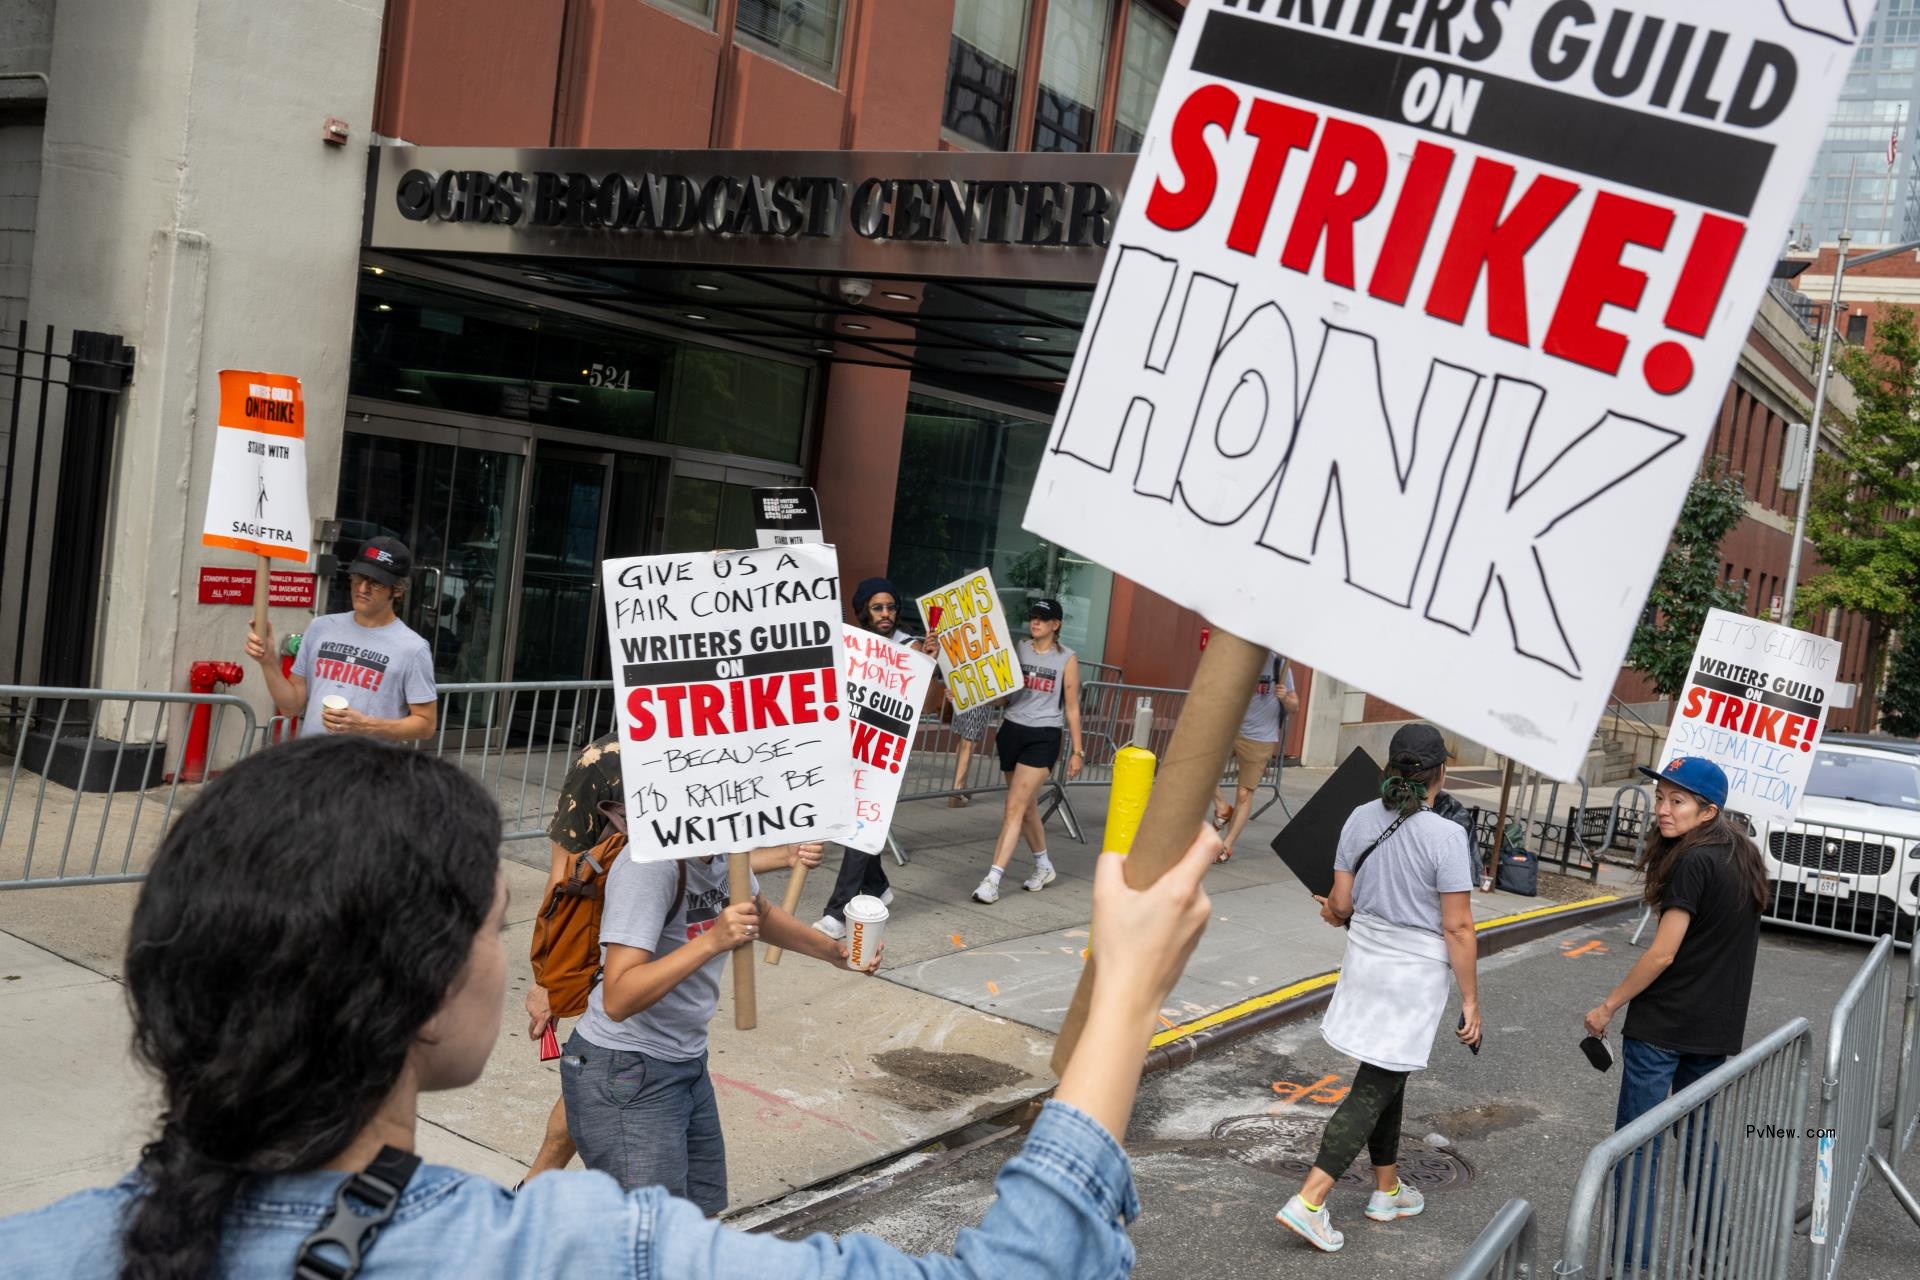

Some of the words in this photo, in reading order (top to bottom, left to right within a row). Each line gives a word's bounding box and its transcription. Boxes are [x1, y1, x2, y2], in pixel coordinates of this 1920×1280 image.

[1530, 0, 1800, 131] GUILD
[1402, 66, 1485, 136] ON
[434, 169, 527, 226] CBS
[529, 171, 845, 237] BROADCAST
[850, 176, 1112, 248] CENTER
[1145, 84, 1747, 396] STRIKE!
[589, 363, 630, 392] 524
[268, 444, 290, 460] WITH
[1051, 245, 1686, 681] HONK
[618, 561, 694, 590] GIVE
[713, 555, 758, 579] US
[776, 553, 800, 571] A
[615, 594, 678, 629] FAIR
[691, 576, 839, 617] CONTRACT
[321, 640, 361, 656] WRITERS
[361, 648, 390, 665] GUILD
[620, 629, 743, 664] WRITERS
[750, 620, 831, 652] GUILD
[865, 638, 913, 670] HAVE
[939, 615, 1000, 669] WGA
[315, 658, 385, 693] STRIKE!
[716, 658, 745, 679] ON
[948, 648, 1015, 711] CREW
[1699, 656, 1769, 688] WRITERS
[1772, 677, 1825, 704] GUILD
[626, 667, 840, 742] STRIKE!
[869, 690, 914, 722] GUILD
[1745, 687, 1764, 702] ON
[1682, 686, 1819, 753] STRIKE!
[1675, 722, 1795, 775] SYSTEMATIC
[631, 783, 669, 819] I'D
[686, 776, 770, 808] RATHER
[781, 766, 825, 791] BE
[651, 803, 818, 848] WRITING
[851, 922, 864, 966] DUNKIN'
